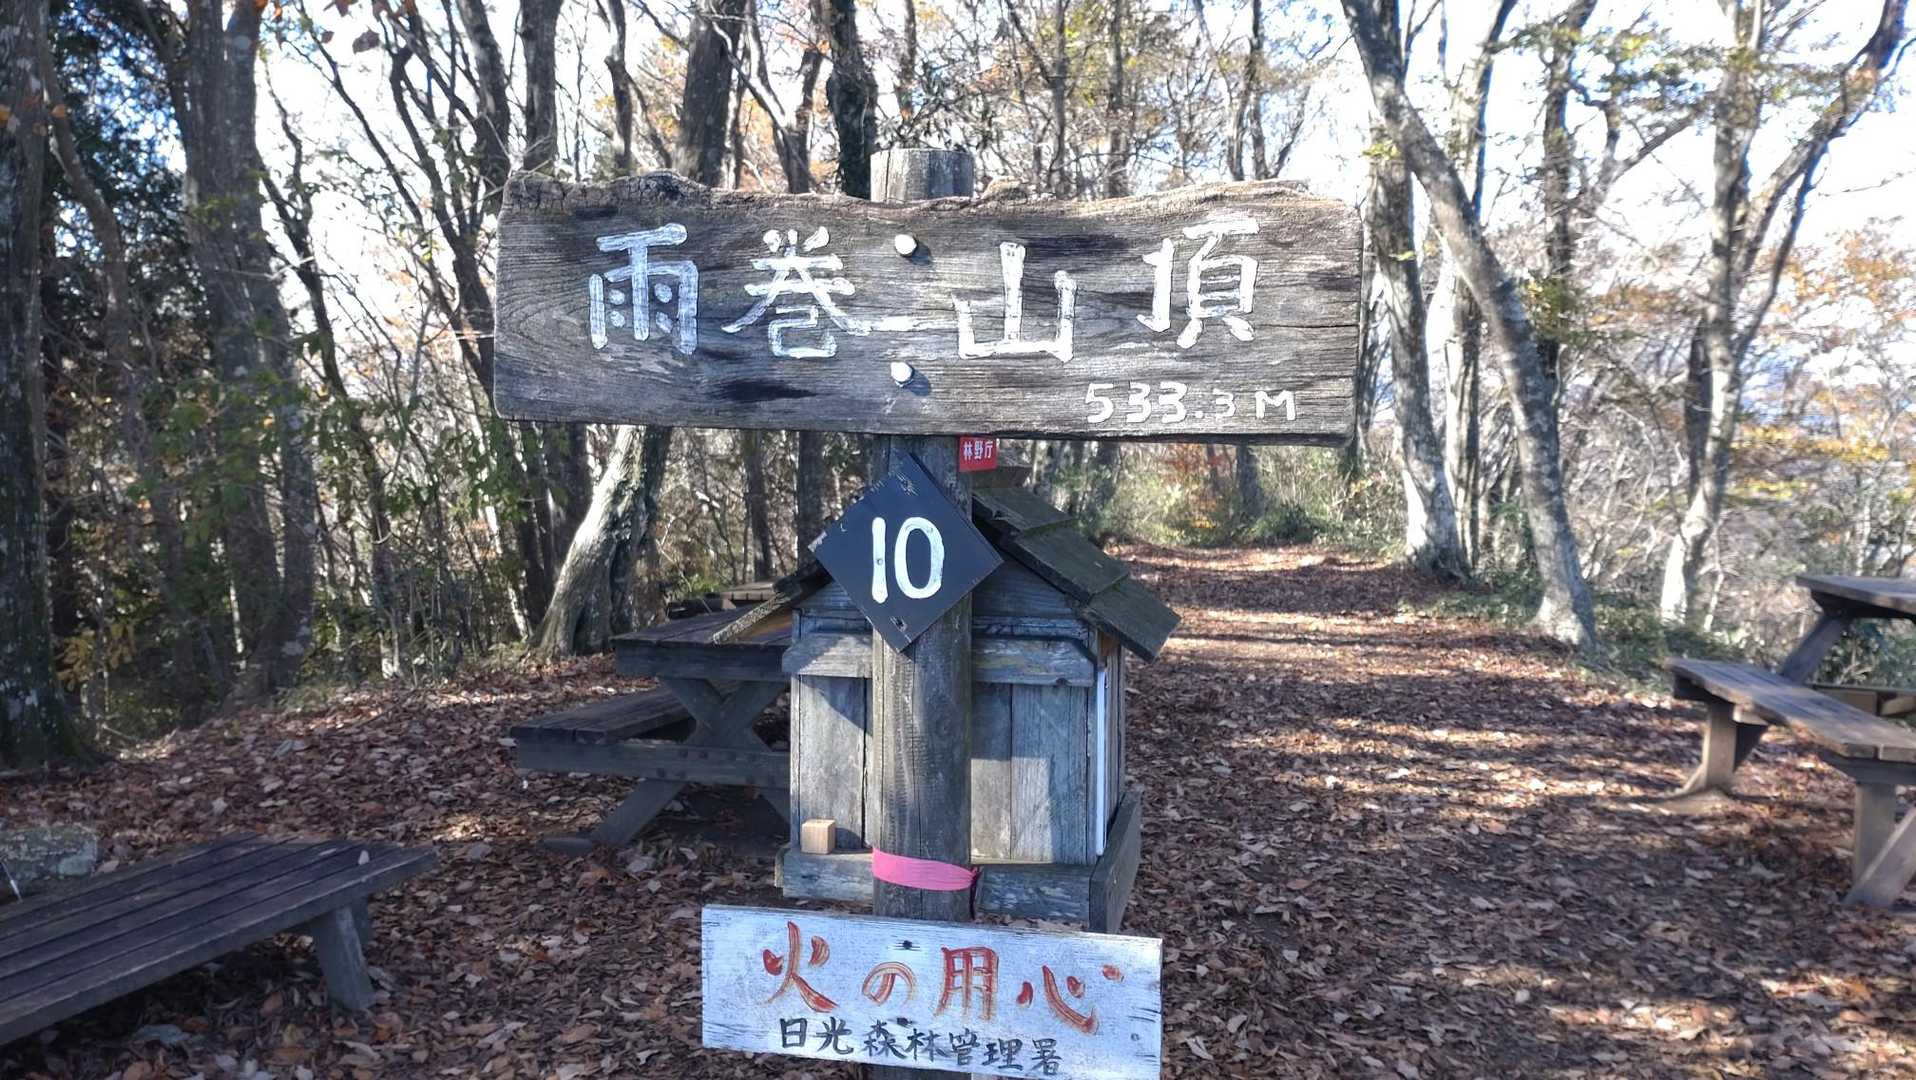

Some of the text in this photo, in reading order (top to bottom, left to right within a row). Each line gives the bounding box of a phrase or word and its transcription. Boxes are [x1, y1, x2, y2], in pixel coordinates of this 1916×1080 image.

[588, 218, 1260, 361] 雨巻山頂
[963, 440, 994, 461] 林野庁
[872, 516, 945, 603] 10
[762, 921, 1125, 1034] 火の用心
[779, 1016, 1063, 1076] 日光森林管理署
